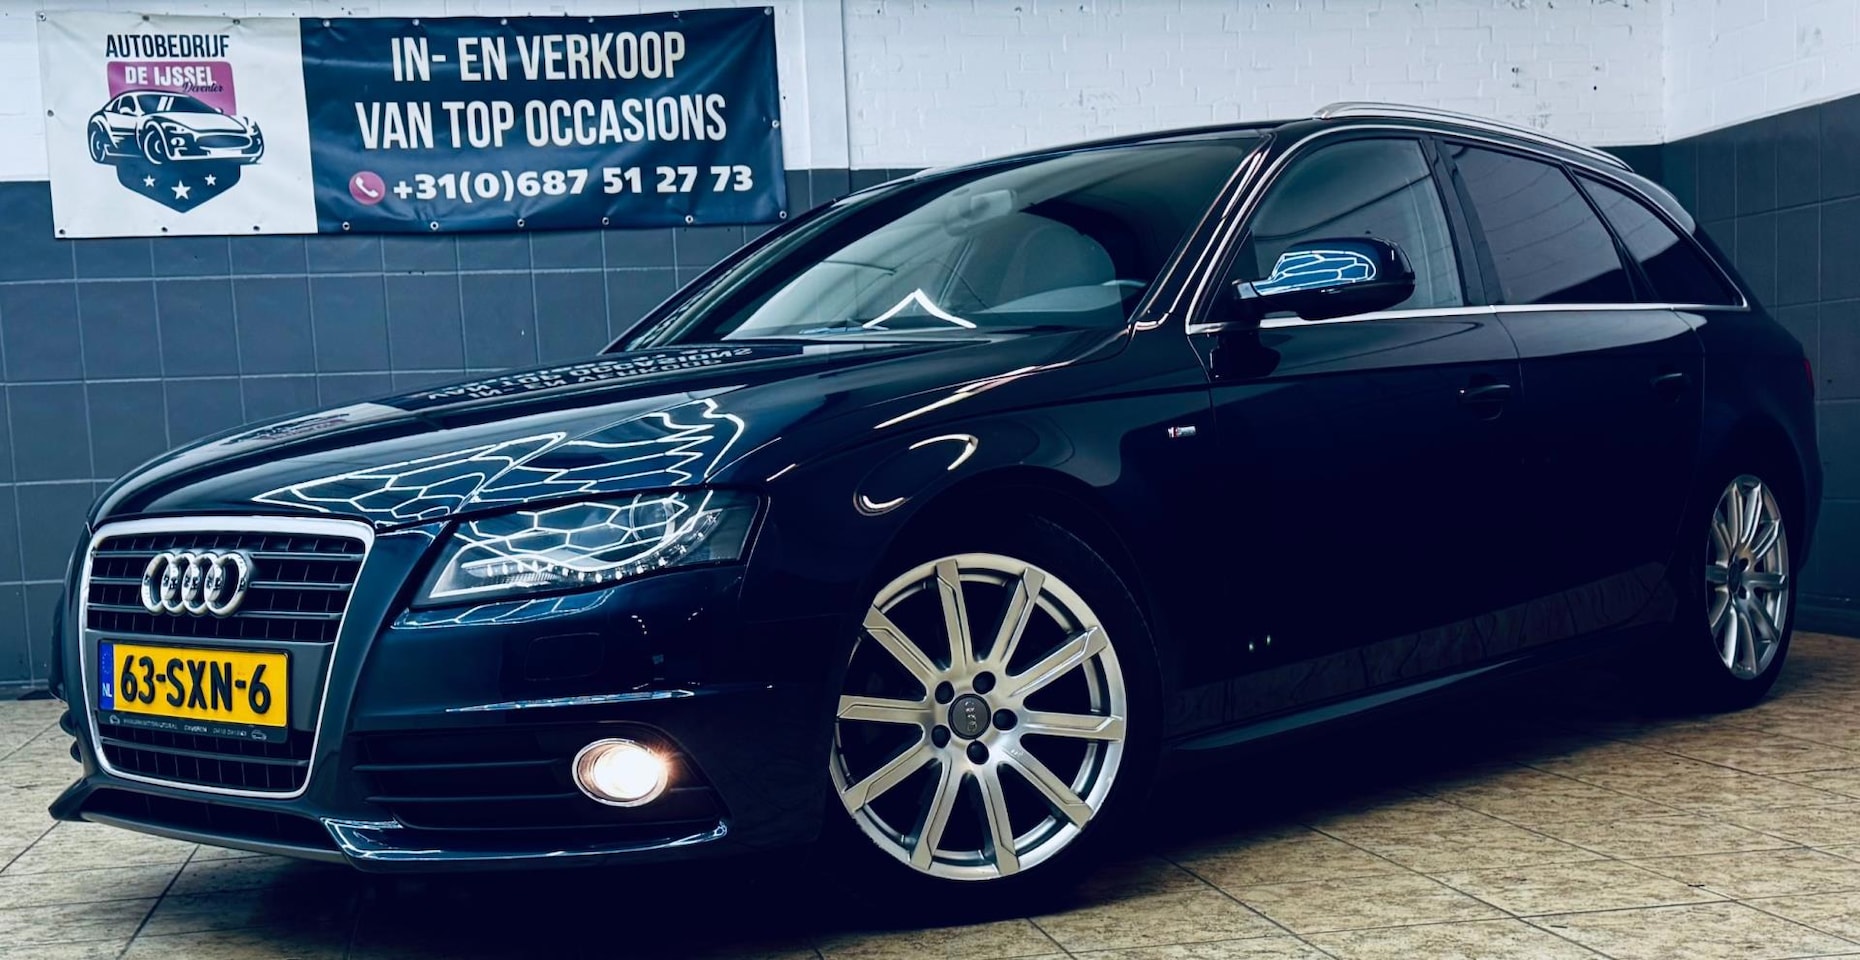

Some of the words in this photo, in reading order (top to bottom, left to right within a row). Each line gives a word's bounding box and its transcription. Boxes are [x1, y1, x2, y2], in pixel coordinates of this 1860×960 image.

[105, 34, 230, 58] AUTOBEDRIJF
[391, 37, 447, 82] IN-
[457, 36, 507, 81] EN
[515, 31, 686, 81] VERKOOP
[125, 66, 148, 85] DE
[154, 65, 216, 87] IJSSEL
[181, 80, 224, 93] Deventer
[354, 101, 434, 149] VAN
[442, 100, 515, 148] TOP
[524, 93, 727, 147] OCCASIONS
[393, 168, 589, 203] +31(0)687
[603, 166, 643, 194] 51
[656, 166, 698, 193] 27
[709, 165, 754, 192] 73
[102, 682, 113, 698] NL
[120, 655, 272, 715] 63-SXN-6
